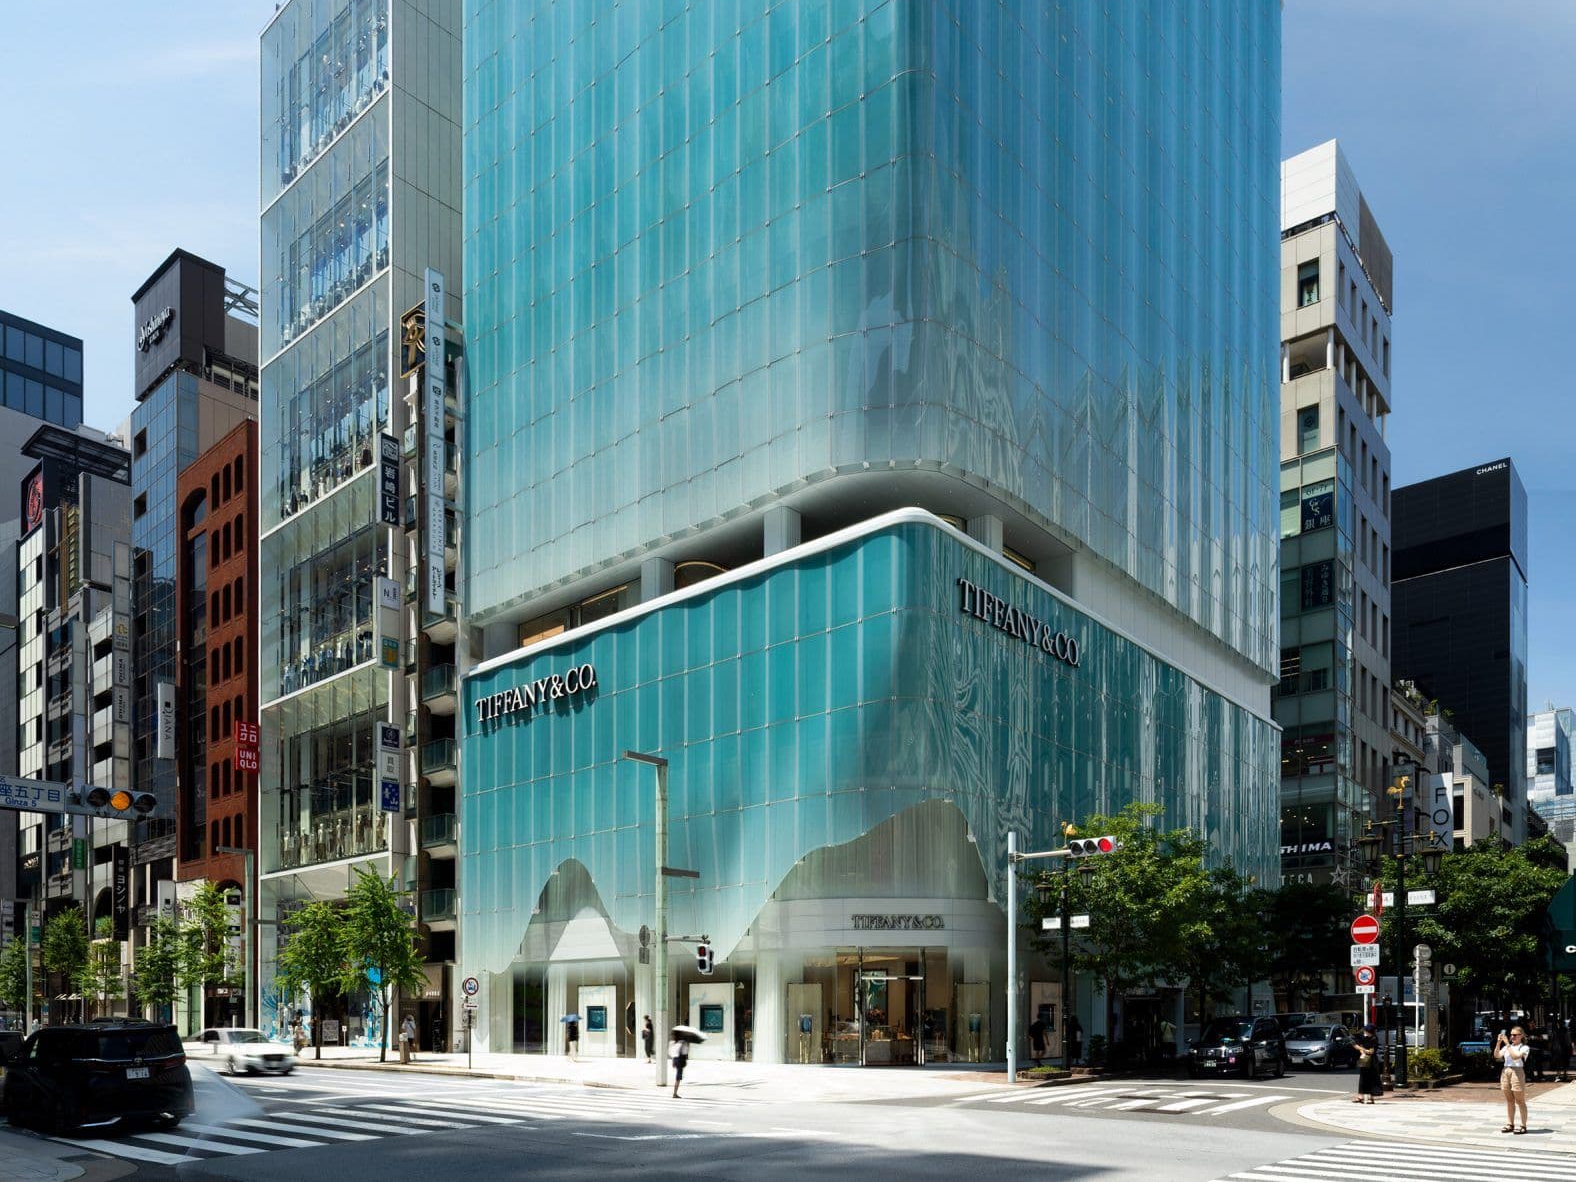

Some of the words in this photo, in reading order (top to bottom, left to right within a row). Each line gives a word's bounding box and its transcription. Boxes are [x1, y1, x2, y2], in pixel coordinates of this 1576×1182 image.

[1476, 462, 1507, 475] CHANEL
[959, 578, 1081, 668] TIFFANY&CO.
[474, 663, 597, 723] TIFFANY&CO.
[240, 750, 256, 760] UNI
[240, 759, 257, 769] QLO
[5, 797, 28, 807] Ginza
[31, 799, 37, 807] 5
[115, 874, 126, 914] ヨシノヤ
[851, 915, 945, 929] TIFFANY&CO.
